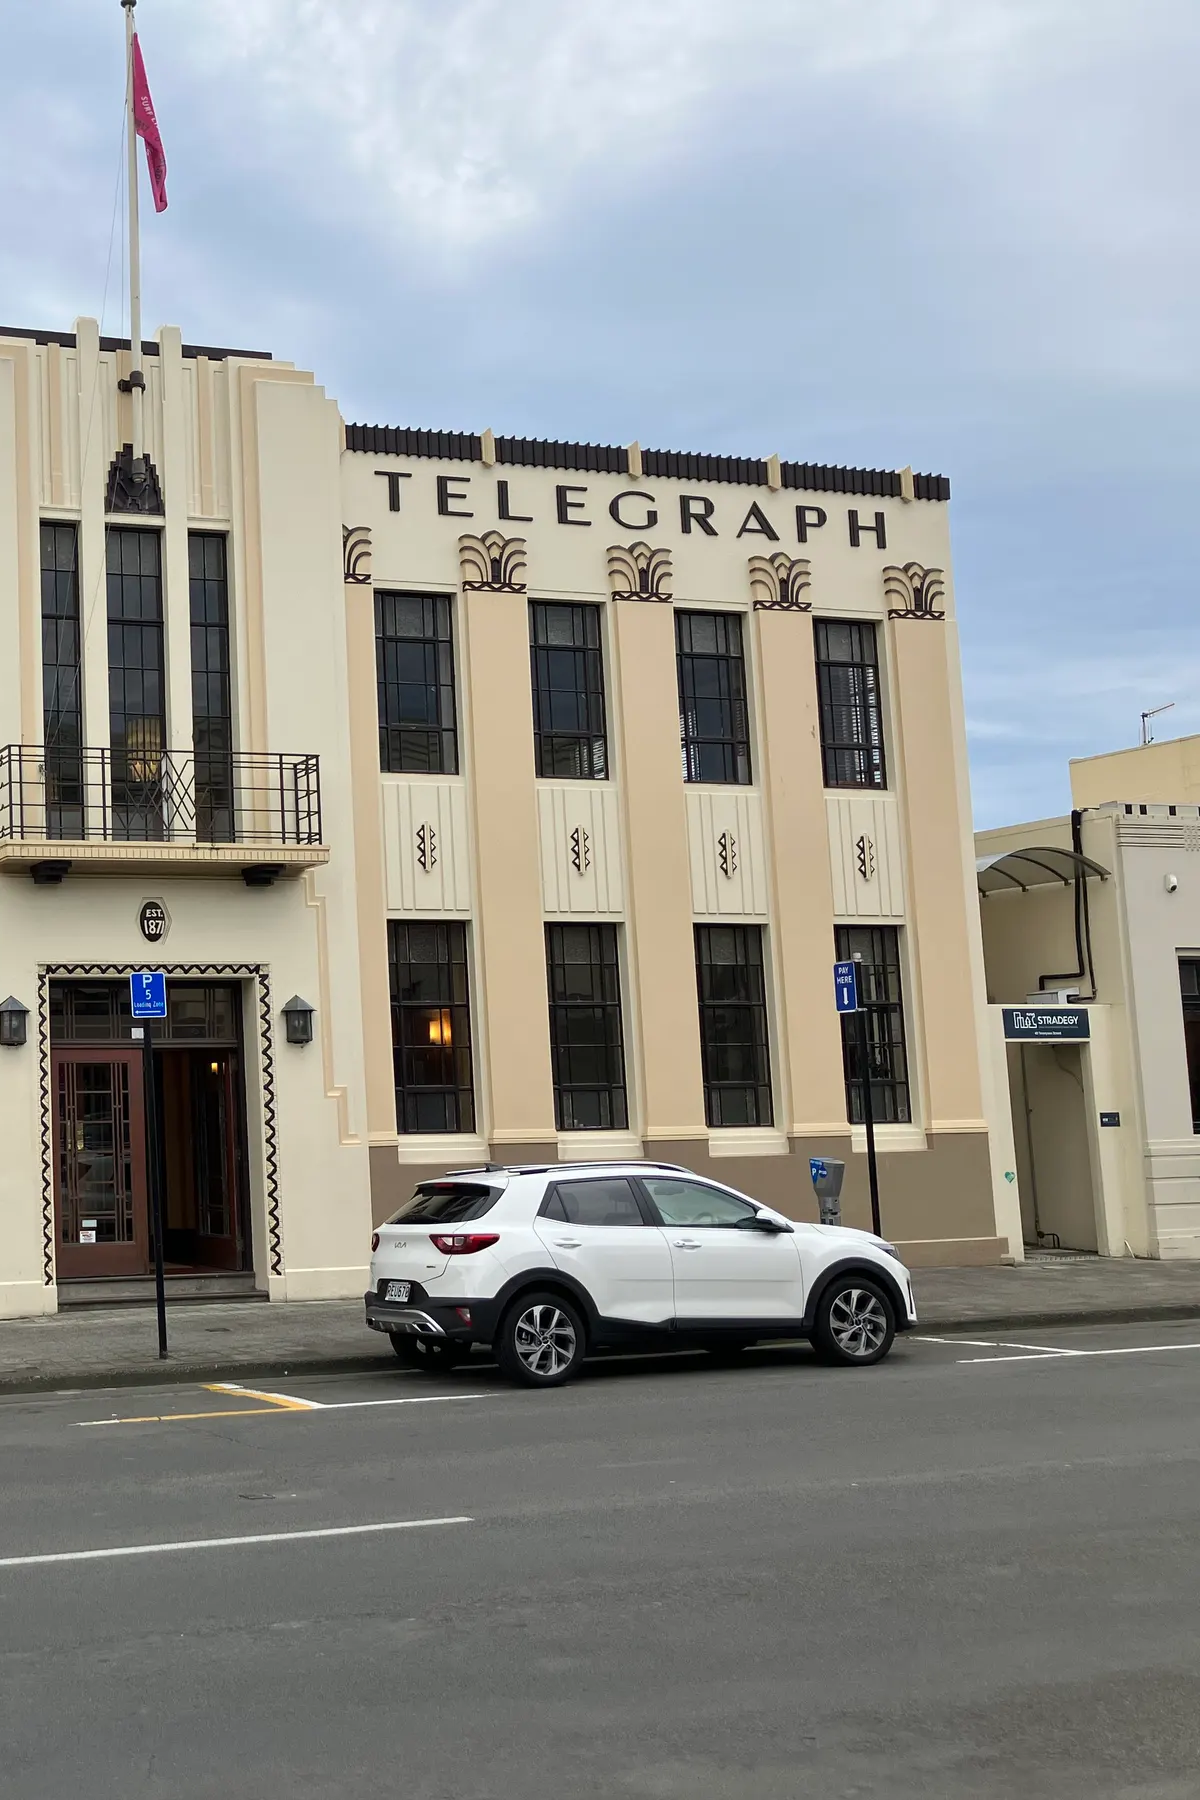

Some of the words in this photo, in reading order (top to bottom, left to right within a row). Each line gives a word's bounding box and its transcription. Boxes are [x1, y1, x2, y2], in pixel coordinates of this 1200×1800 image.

[374, 470, 888, 549] TELEGRAPH
[145, 908, 163, 918] EST.
[143, 920, 165, 934] 1871
[838, 966, 849, 975] PAY
[142, 974, 153, 988] P
[836, 975, 853, 984] HERE
[145, 989, 152, 1000] 5
[1037, 1016, 1079, 1025] STRADEGY
